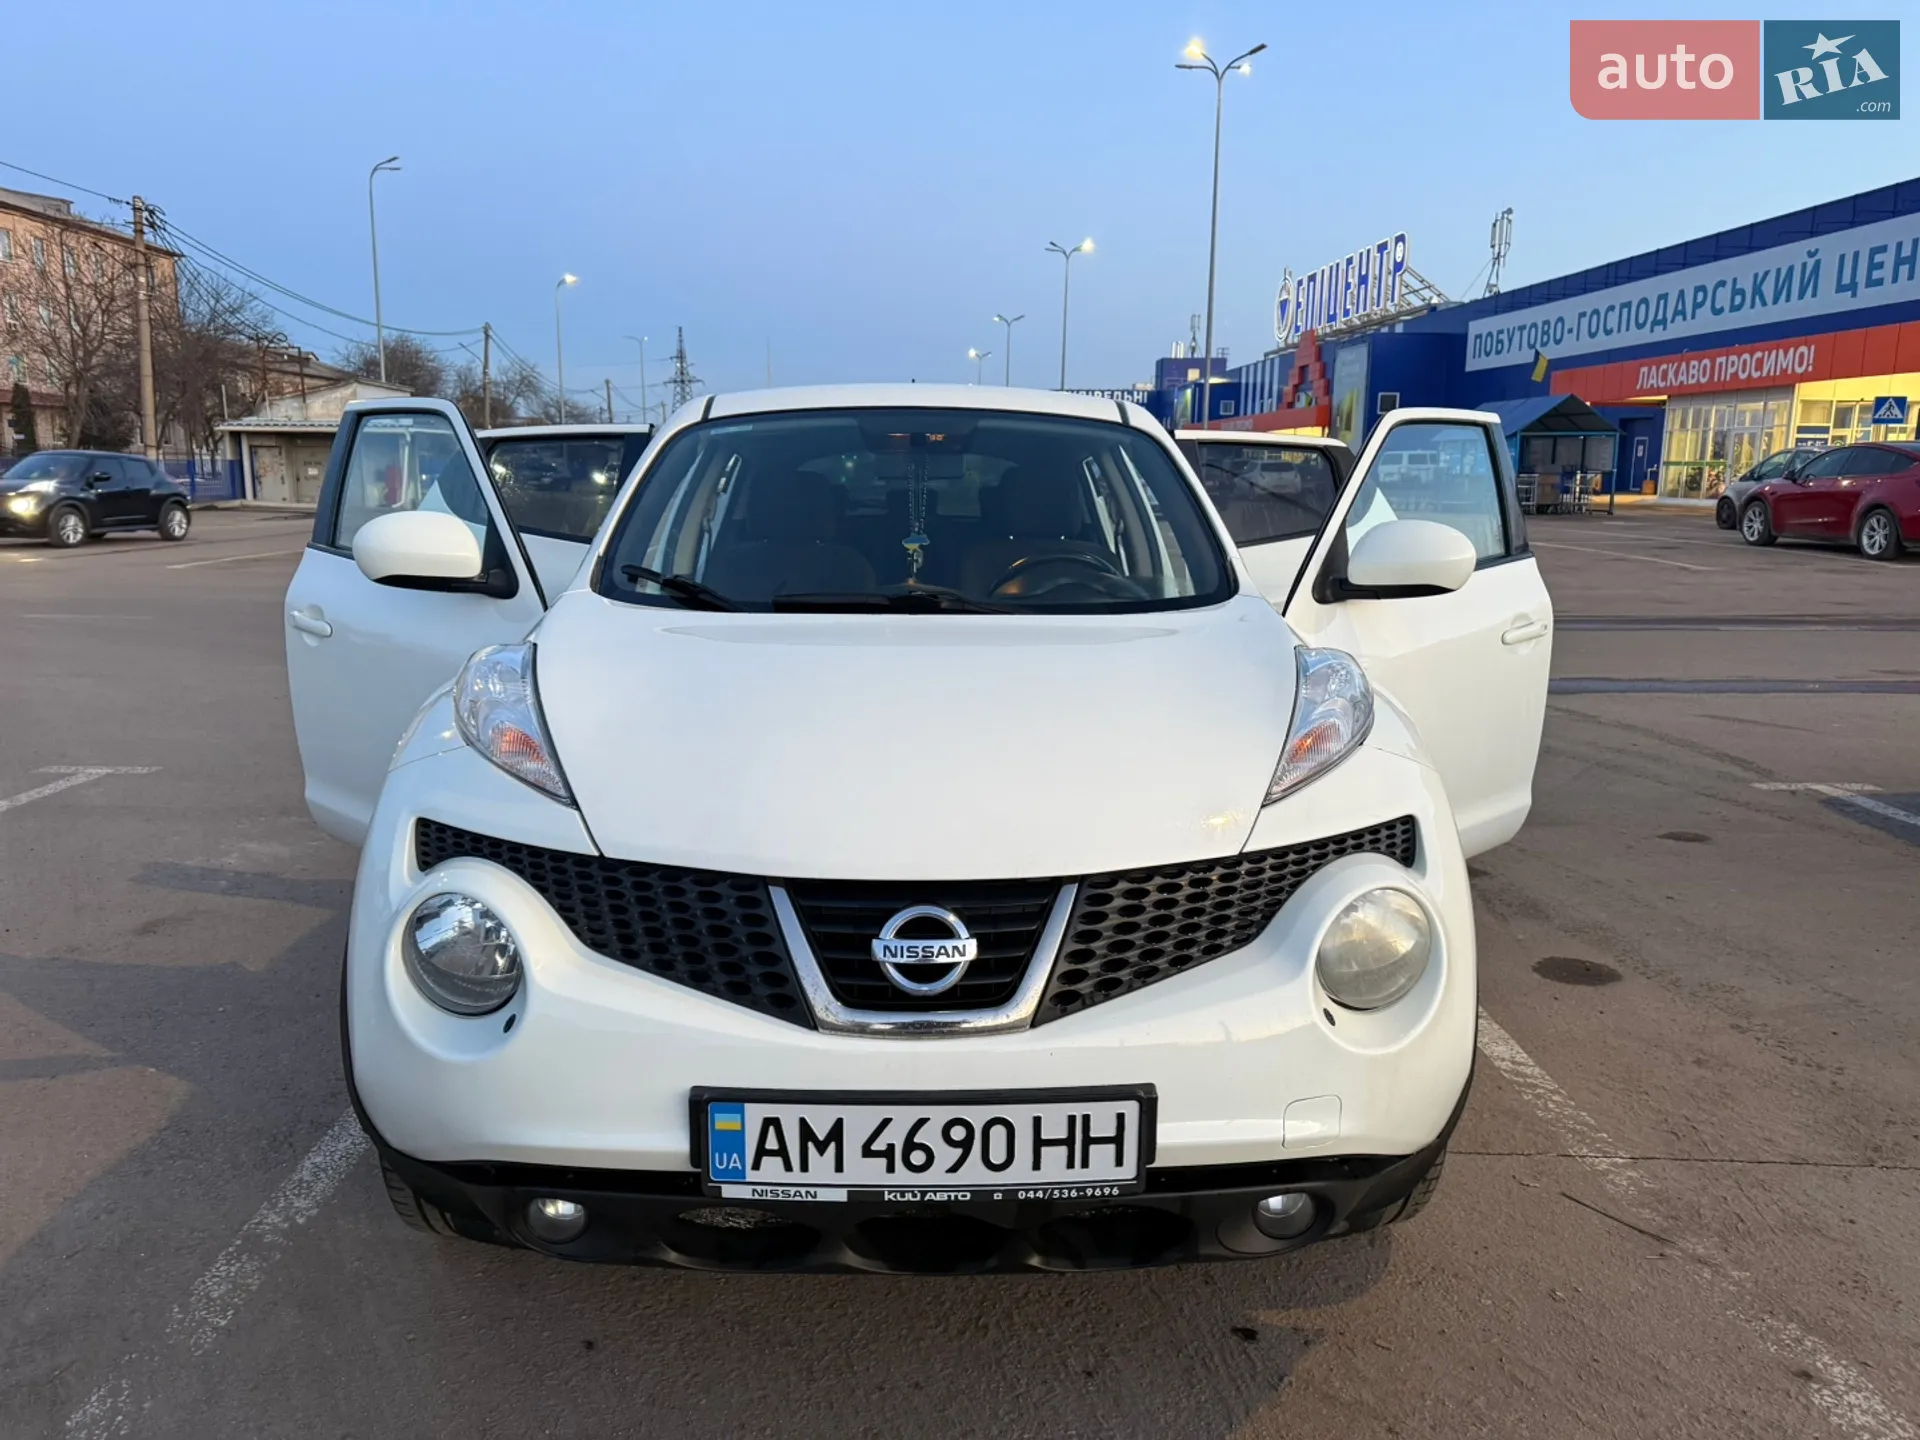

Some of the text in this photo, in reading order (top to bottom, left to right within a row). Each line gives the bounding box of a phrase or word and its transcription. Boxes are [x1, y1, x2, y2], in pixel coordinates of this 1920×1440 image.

[1294, 231, 1408, 336] ЕПІЦЕНТР
[1472, 248, 1822, 360] ПОБУТОВО-ГОСПОДАРСЬКИЙ
[1636, 345, 1815, 390] ЛАСКАВО ПРОСИМО!
[882, 944, 967, 959] NISSAN
[751, 1112, 1126, 1174] AM 4690 HH
[715, 1152, 742, 1170] UA
[752, 1188, 817, 1199] NISSAN
[1018, 1186, 1120, 1200] 044/536-9696
